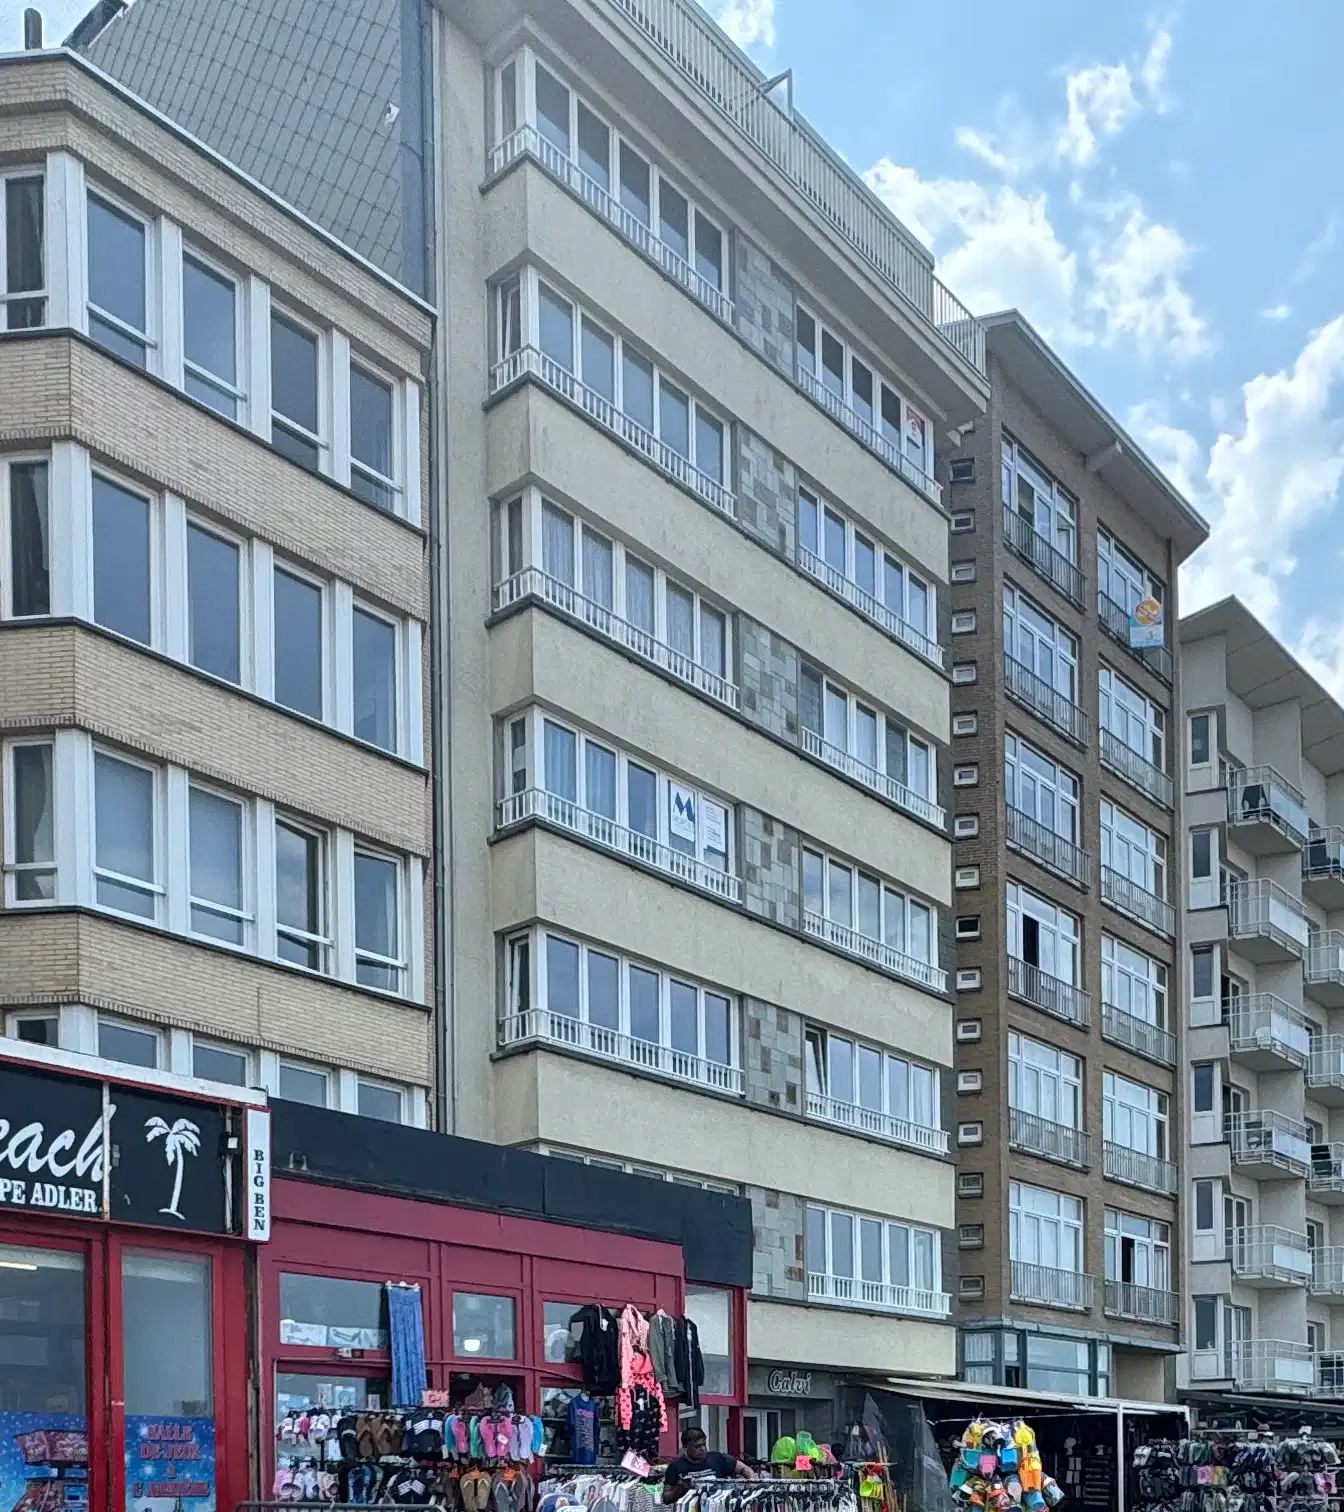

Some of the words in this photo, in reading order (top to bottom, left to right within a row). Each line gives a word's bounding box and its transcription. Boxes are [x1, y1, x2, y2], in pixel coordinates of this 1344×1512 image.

[253, 1148, 264, 1187] BIG
[29, 1179, 98, 1213] ADLER
[253, 1190, 265, 1231] BEN
[769, 1369, 811, 1395] Calvi
